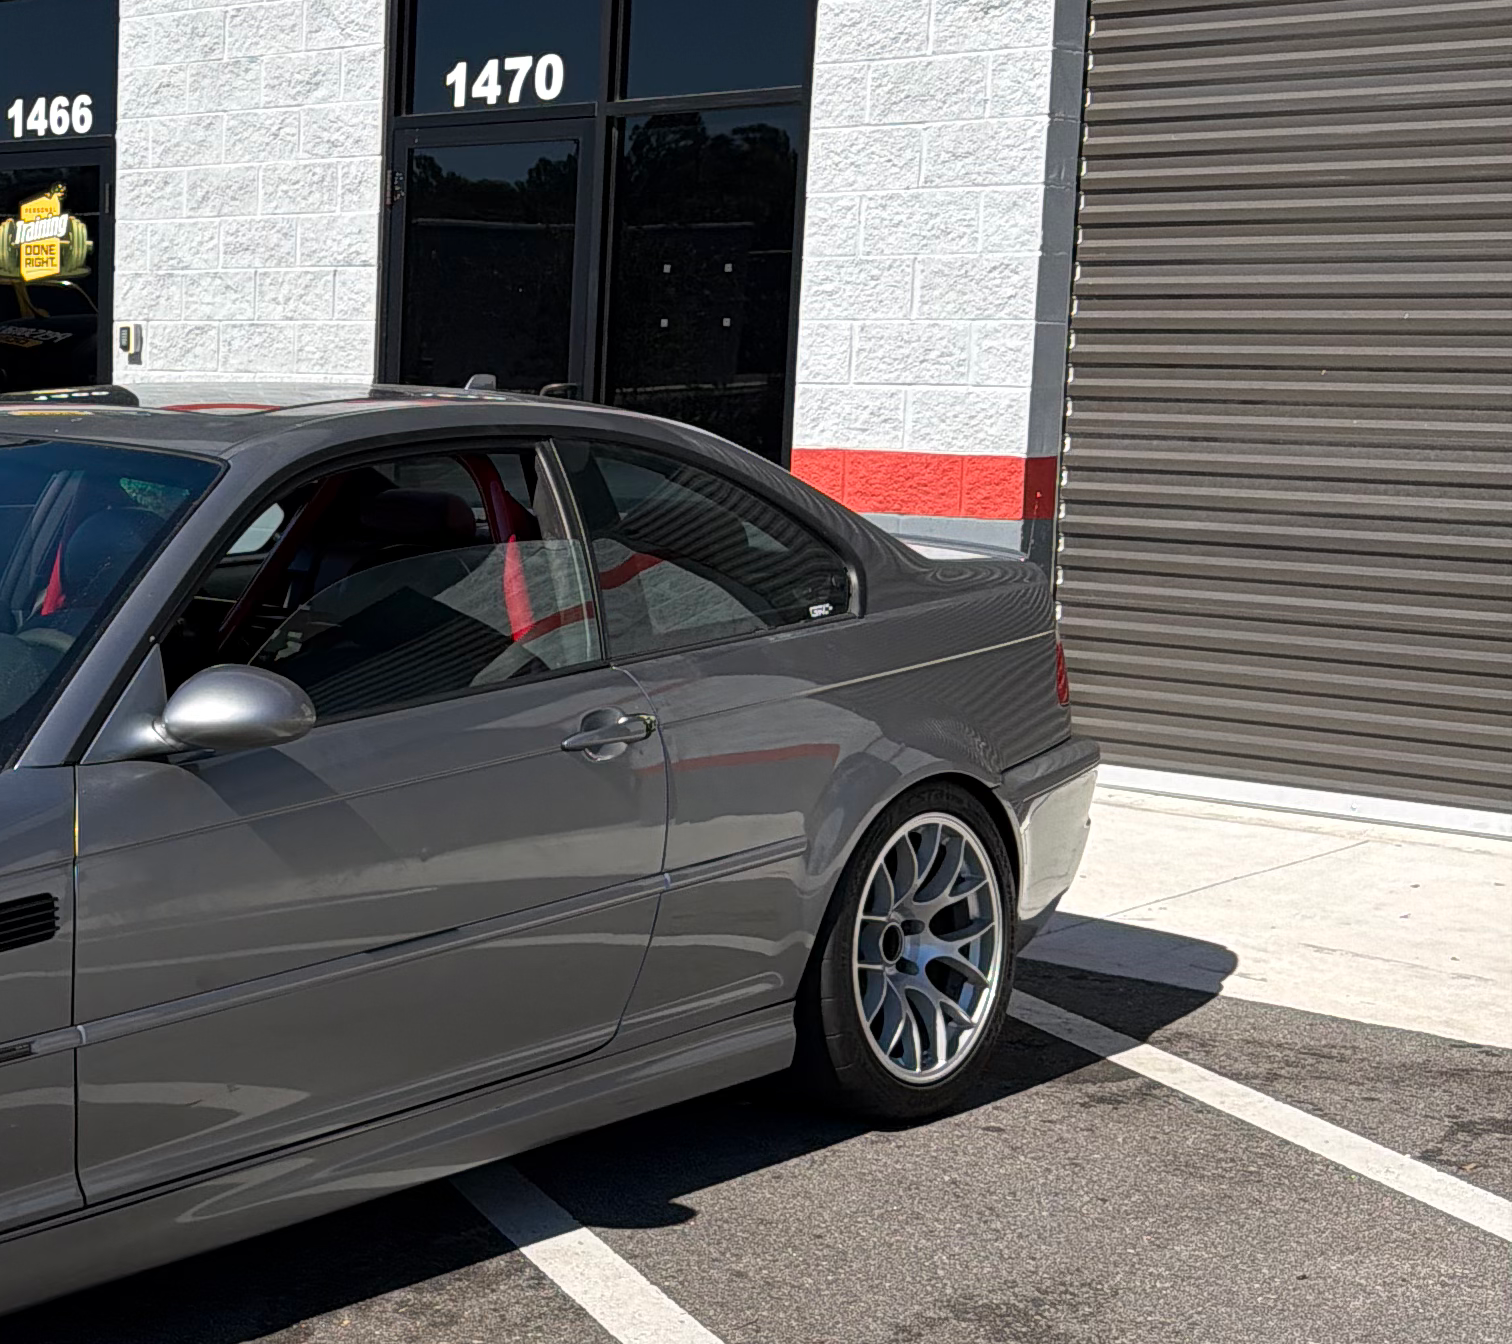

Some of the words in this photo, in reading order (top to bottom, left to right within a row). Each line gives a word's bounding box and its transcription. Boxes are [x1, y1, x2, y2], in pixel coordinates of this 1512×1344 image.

[445, 53, 564, 108] 1470
[7, 94, 93, 138] 1466
[15, 213, 68, 244] Training
[25, 244, 56, 257] DONE
